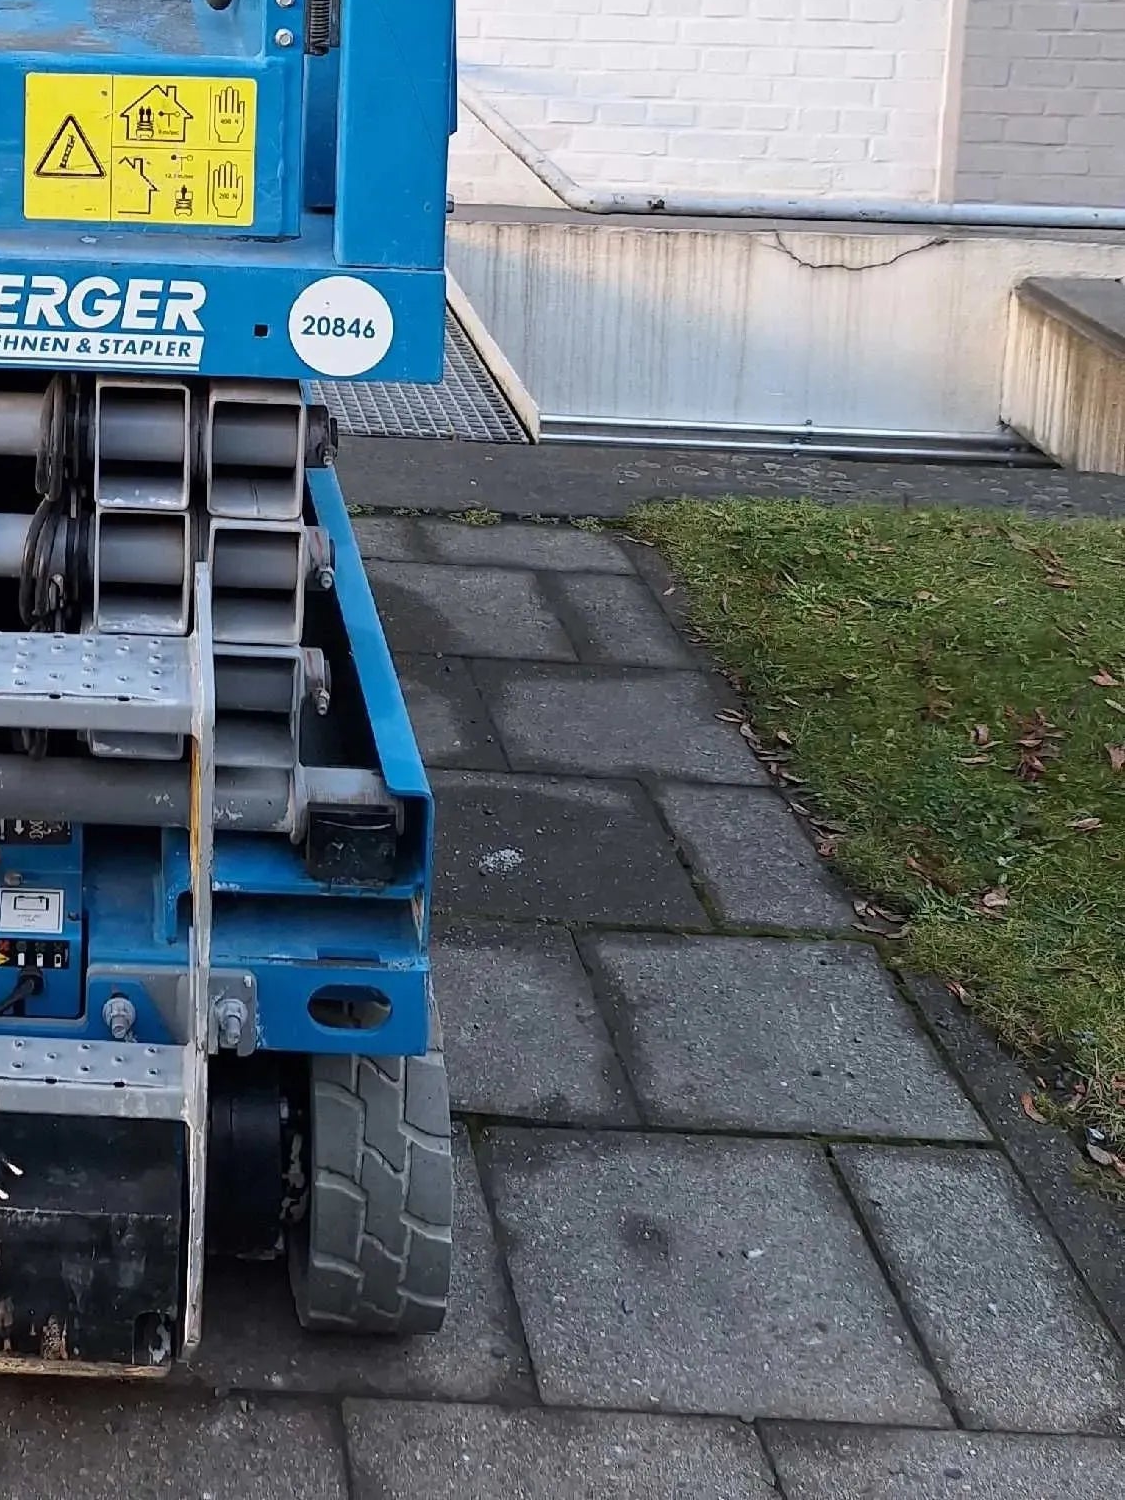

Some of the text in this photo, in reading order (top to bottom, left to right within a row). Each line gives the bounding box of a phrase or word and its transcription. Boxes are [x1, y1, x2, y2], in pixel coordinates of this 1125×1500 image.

[300, 314, 376, 339] 20846
[75, 337, 92, 354] &
[98, 338, 192, 358] STAPLER
